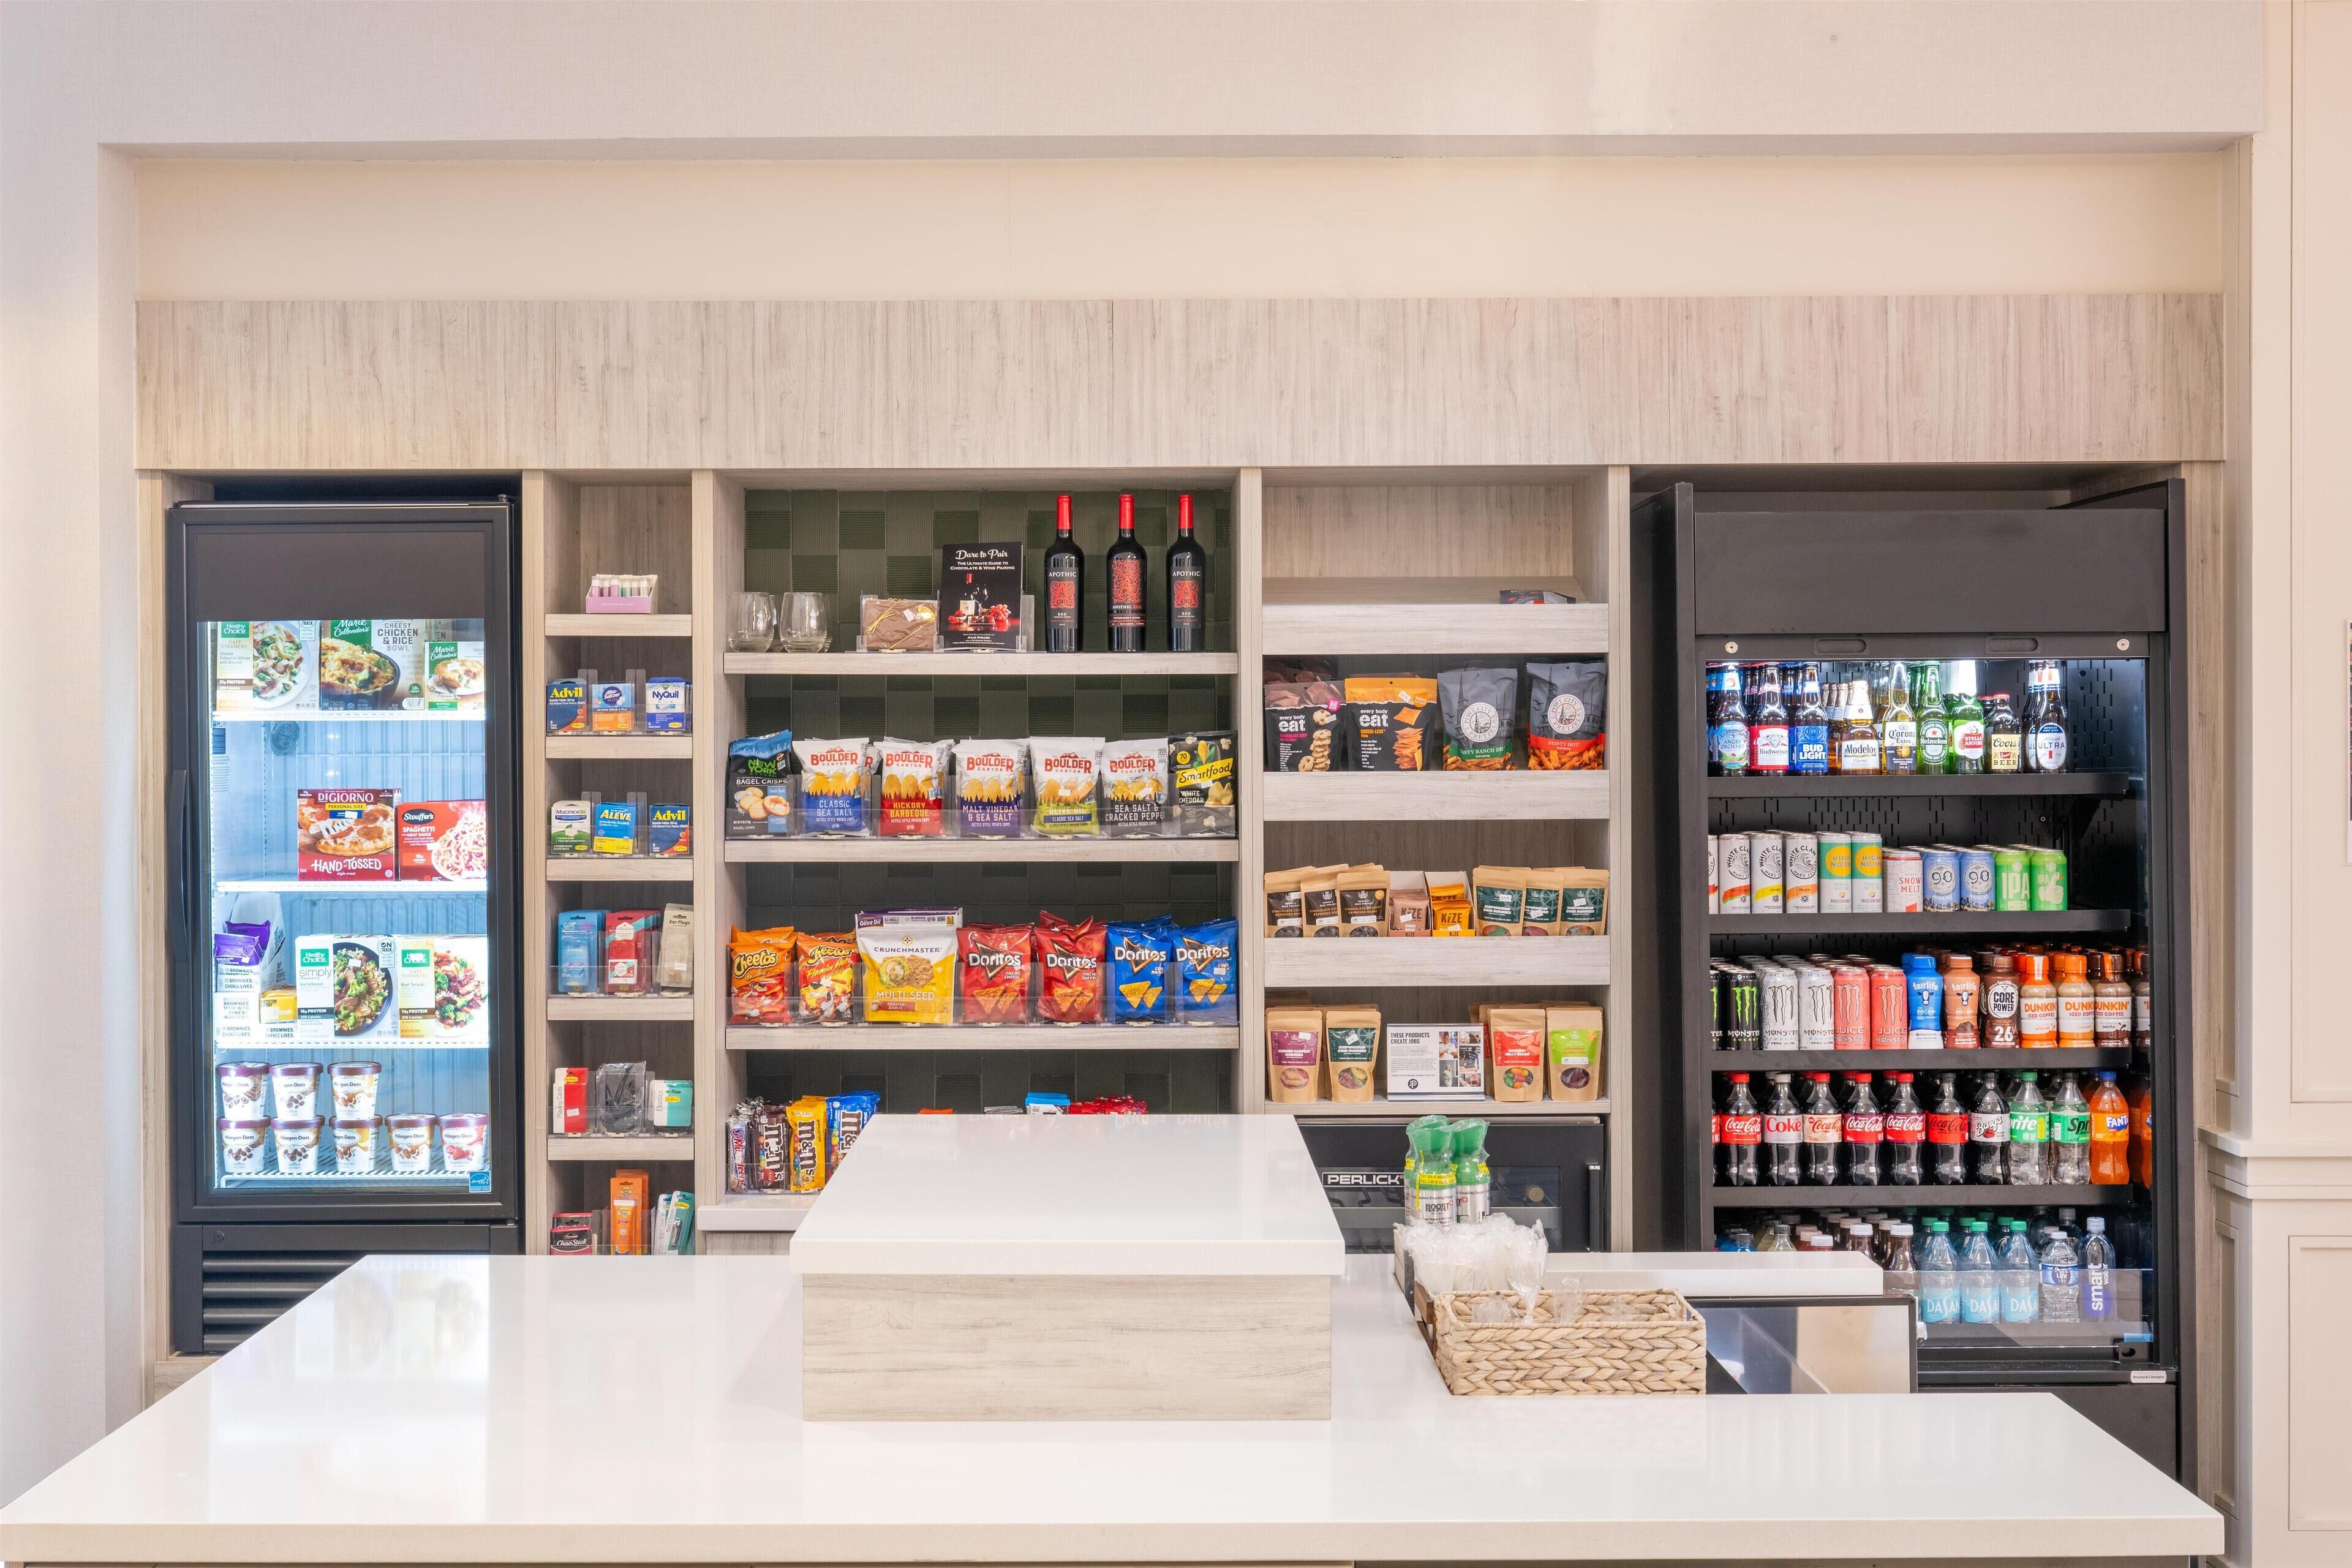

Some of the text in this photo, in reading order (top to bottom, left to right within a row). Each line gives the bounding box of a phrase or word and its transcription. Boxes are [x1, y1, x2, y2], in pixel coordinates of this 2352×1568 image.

[956, 550, 979, 560] Dare
[335, 620, 367, 628] Marie
[551, 687, 582, 698] Advil
[652, 691, 679, 699] NyQuil
[1551, 697, 1577, 714] PORT CITY
[1359, 714, 1389, 727] eat
[1464, 705, 1492, 723] PORT CITY
[1278, 720, 1305, 732] eat
[1470, 719, 1496, 739] PRETZELS
[1889, 729, 1916, 739] Corona
[1846, 744, 1873, 753] Modelo
[1993, 737, 2017, 747] Coors
[811, 752, 858, 766] BOULDER
[886, 753, 933, 768] BOULDER
[1800, 752, 1826, 760] LIGHT
[748, 766, 777, 774] YORK
[967, 756, 1015, 772] BOULDER
[1044, 758, 1093, 774] BOULDER
[1109, 758, 1157, 773] BOULDER
[1178, 764, 1230, 783] Smartfood
[404, 812, 434, 821] Stouffer's
[600, 810, 631, 820] ALEVE
[653, 810, 686, 820] Advil
[1789, 845, 1817, 867] WHITE CLAW
[1932, 871, 1952, 884] 90
[1969, 870, 1989, 884] 90
[2038, 874, 2049, 884] IPA
[2002, 873, 2029, 899] IPA
[968, 952, 1022, 968] Doritos
[1114, 946, 1166, 962] Doritos
[1175, 945, 1230, 961] Doritos
[733, 950, 778, 978] Cheetos
[835, 958, 848, 969] Hot
[1046, 953, 1097, 969] Doritos
[299, 966, 332, 980] simply
[1913, 982, 1939, 990] fairlife
[1952, 982, 1977, 991] fairlife
[876, 990, 935, 1000] MULTI-SEED
[1994, 992, 2014, 1003] CORE
[1725, 1117, 1761, 1133] Coca-Cola
[1766, 1117, 1801, 1133] Coke
[1887, 1116, 1923, 1131] Coca-Cola
[1929, 1116, 1968, 1132] Coca-Cola
[1976, 1115, 2003, 1137] Barq's
[1327, 1175, 1400, 1185] PERLICK
[2088, 1263, 2103, 1311] smart
